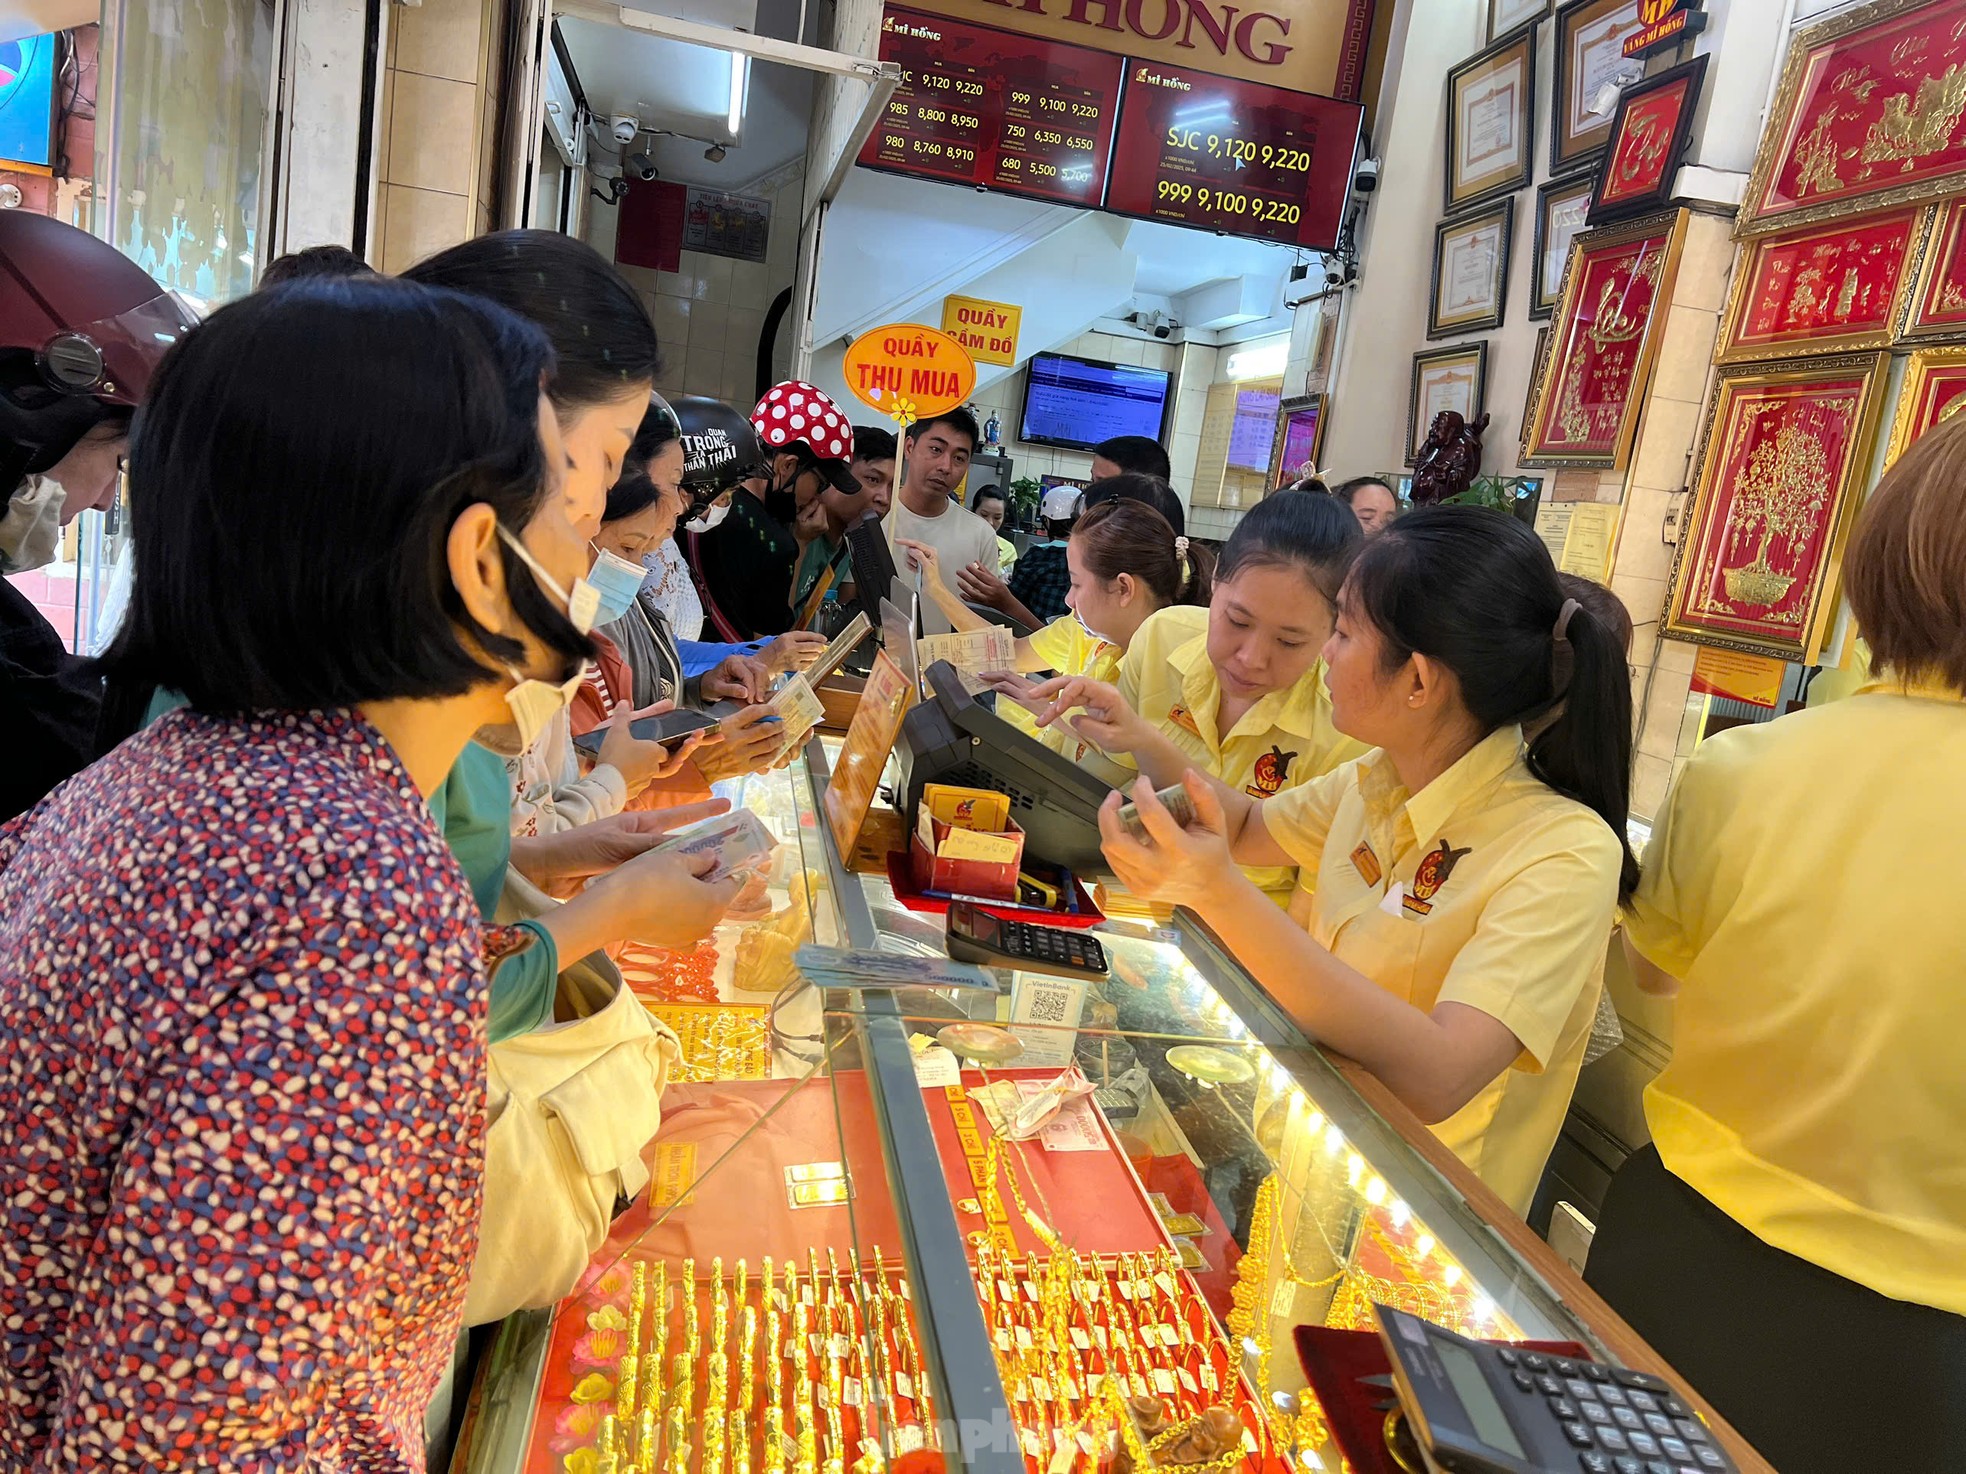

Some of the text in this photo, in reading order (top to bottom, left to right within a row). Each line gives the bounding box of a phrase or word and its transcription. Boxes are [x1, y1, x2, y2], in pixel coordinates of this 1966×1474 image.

[911, 26, 941, 41] HỒNG
[902, 71, 983, 96] JC 9,120 9,220
[1163, 76, 1191, 91] HỒNG
[889, 102, 978, 128] 985 8,800 8,950
[1011, 92, 1098, 118] 999 9,100 9,220
[885, 135, 974, 161] 980 8,760 8,910
[1007, 124, 1093, 150] 750 6,350 6,550
[1166, 127, 1311, 172] SJC 9,120 9,220
[1002, 157, 1088, 182] 680 5,500 5,700
[1157, 180, 1300, 224] 999 9,100 9,220
[958, 308, 1008, 329] QUẦY
[883, 333, 939, 358] QUẦY
[990, 336, 1013, 354] ĐỒ
[910, 368, 960, 398] MUA
